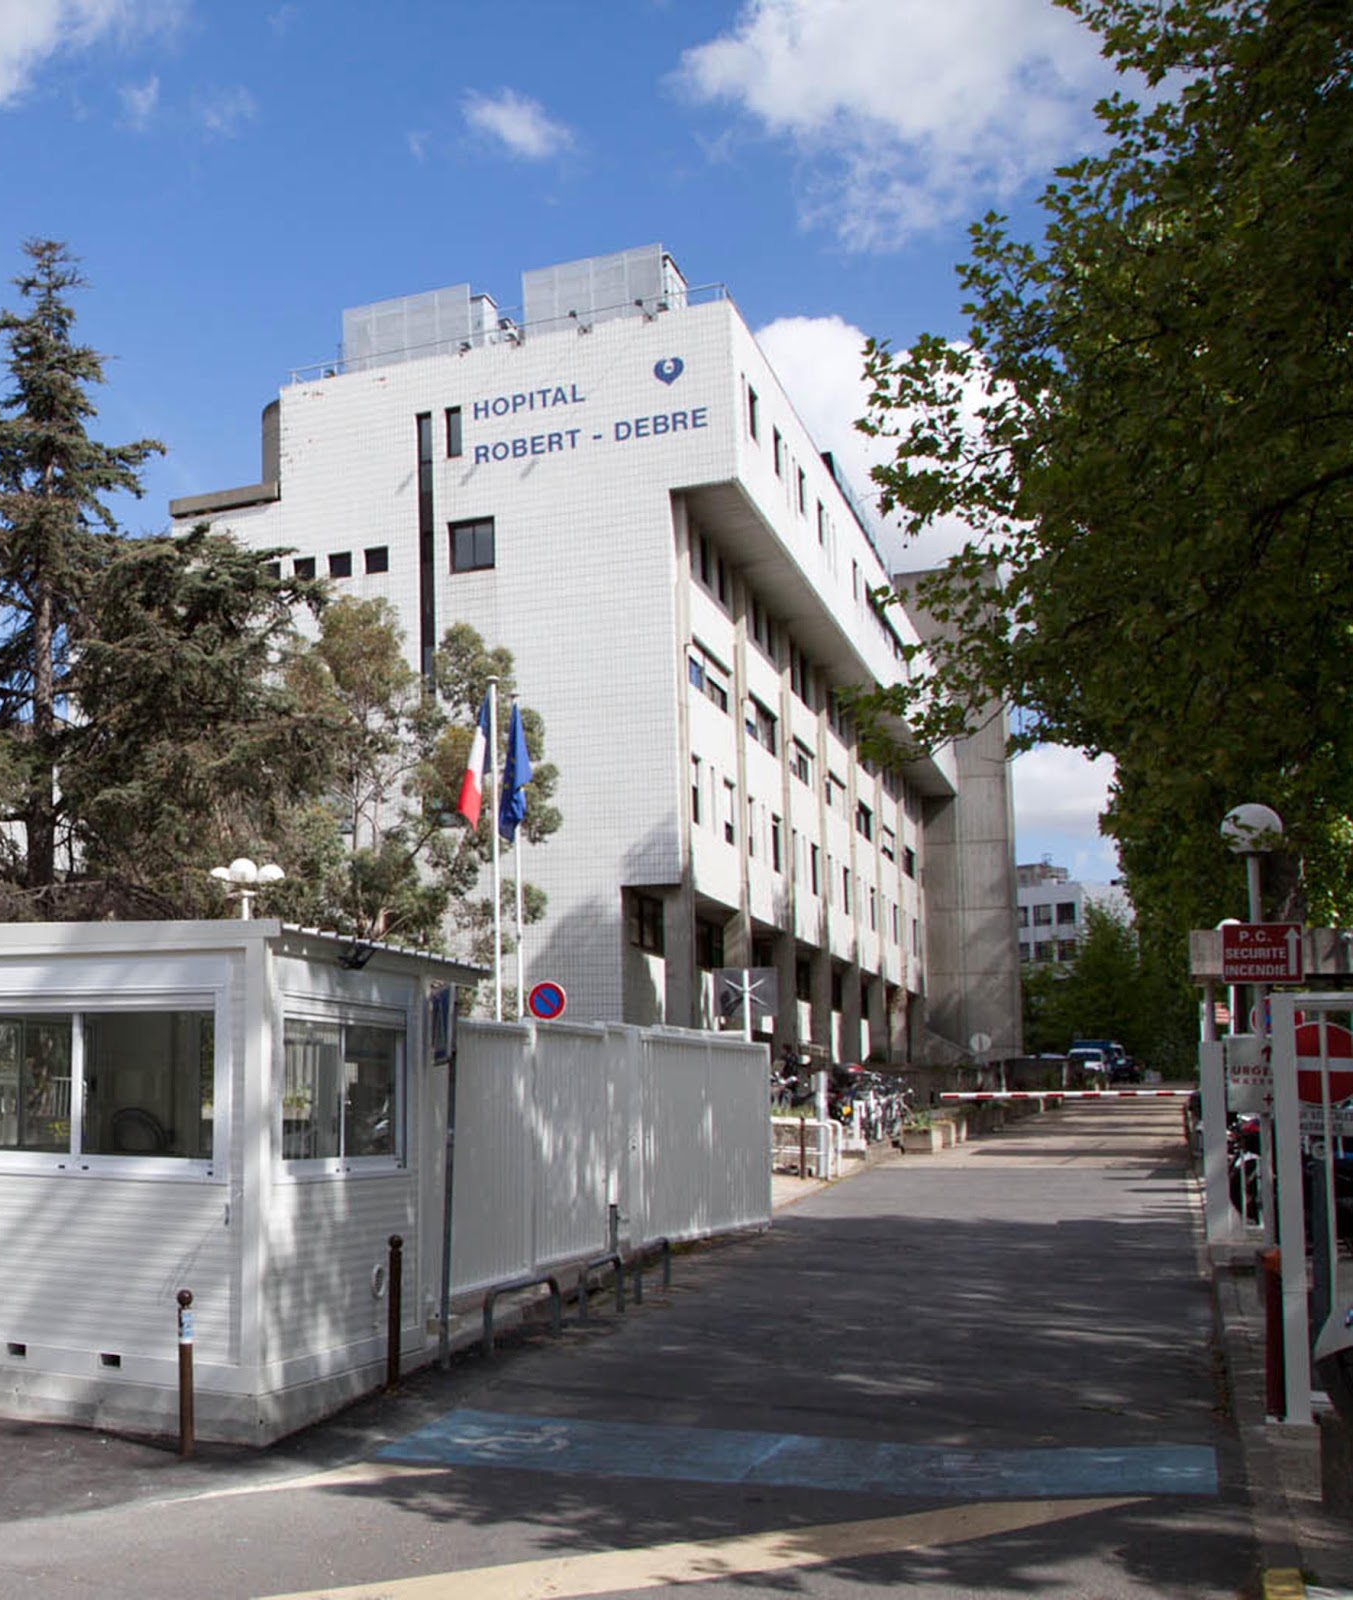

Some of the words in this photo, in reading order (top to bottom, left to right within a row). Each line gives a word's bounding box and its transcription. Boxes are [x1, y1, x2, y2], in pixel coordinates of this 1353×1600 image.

[473, 384, 586, 420] HOPITAL
[474, 429, 581, 465] ROBERT
[614, 407, 709, 442] DEBRE
[1239, 930, 1272, 942] P.C.
[1225, 947, 1287, 959] SECURITE
[1225, 964, 1287, 976] INCENDIE
